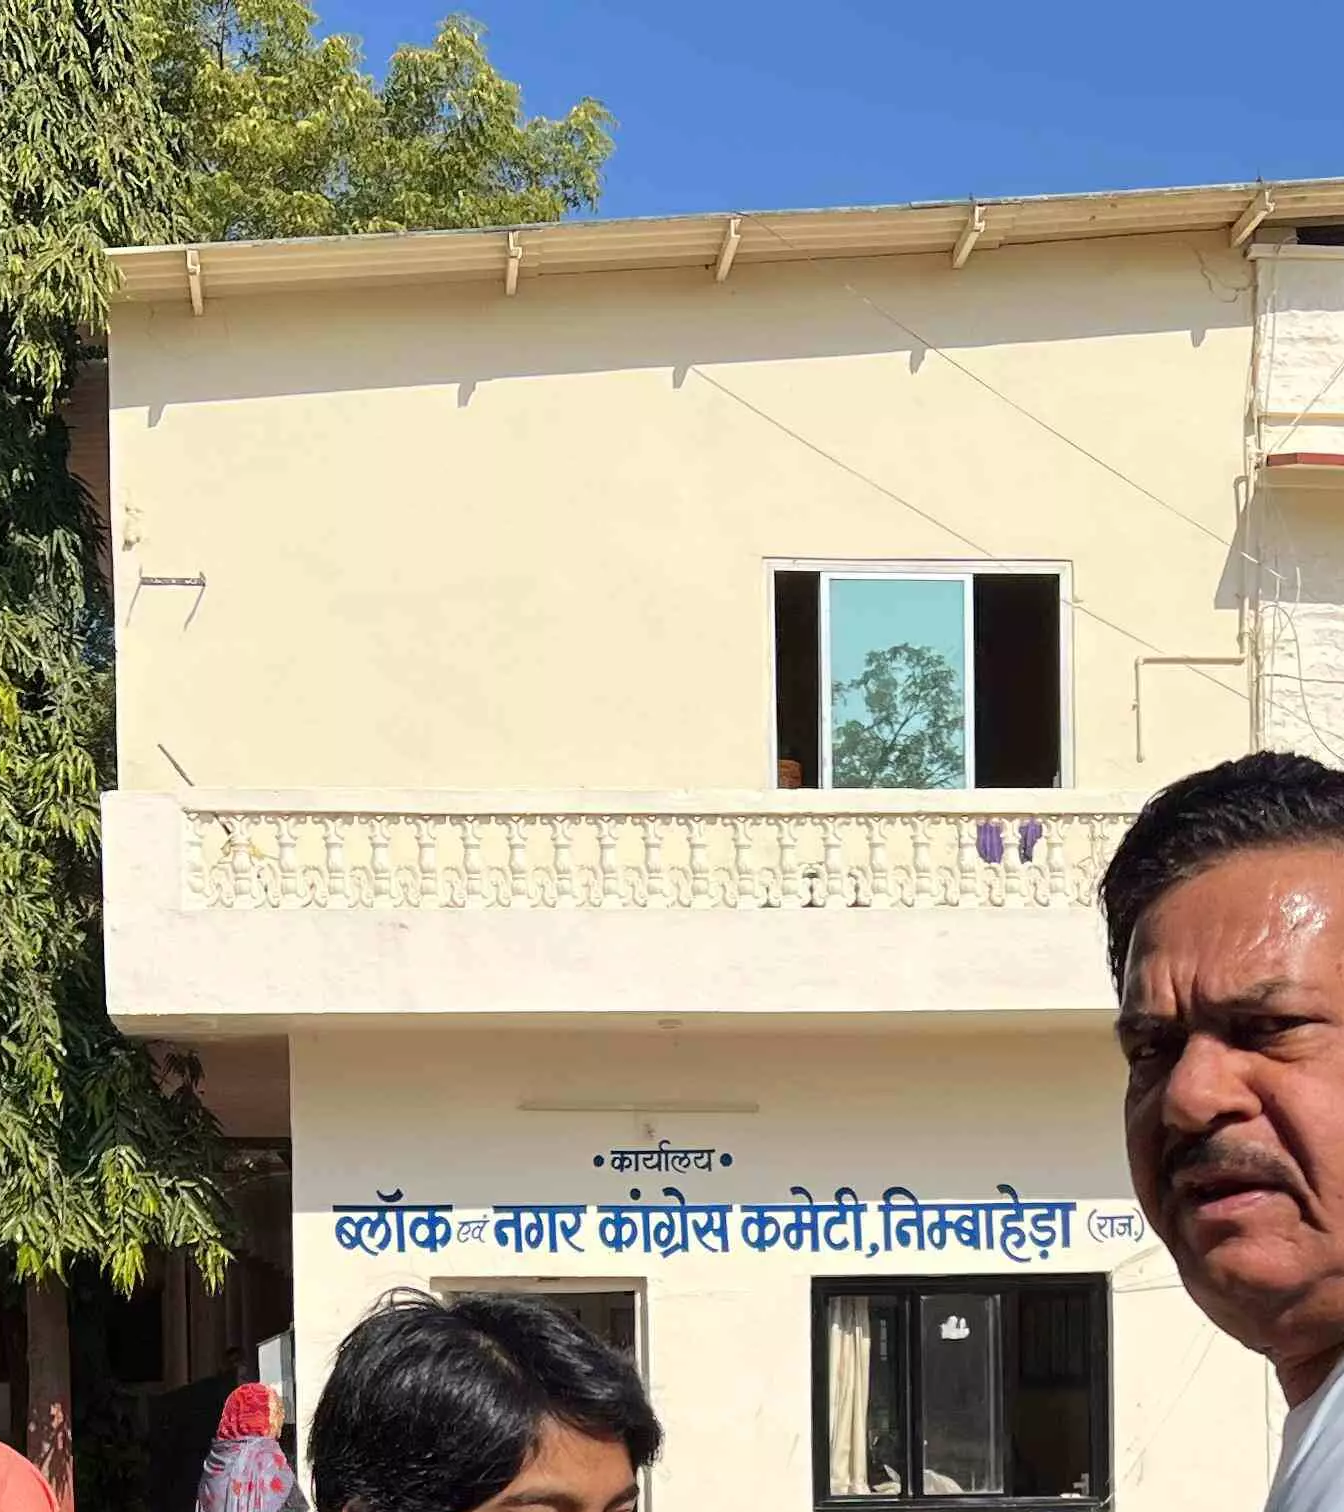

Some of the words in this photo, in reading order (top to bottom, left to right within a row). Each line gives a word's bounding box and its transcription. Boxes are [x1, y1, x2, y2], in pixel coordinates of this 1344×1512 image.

[610, 1140, 716, 1174] कार्यालय
[333, 1188, 453, 1256] ब्लॉक
[457, 1215, 490, 1243] एवं
[492, 1204, 587, 1253] नगर
[597, 1186, 733, 1258] कांग्रेस
